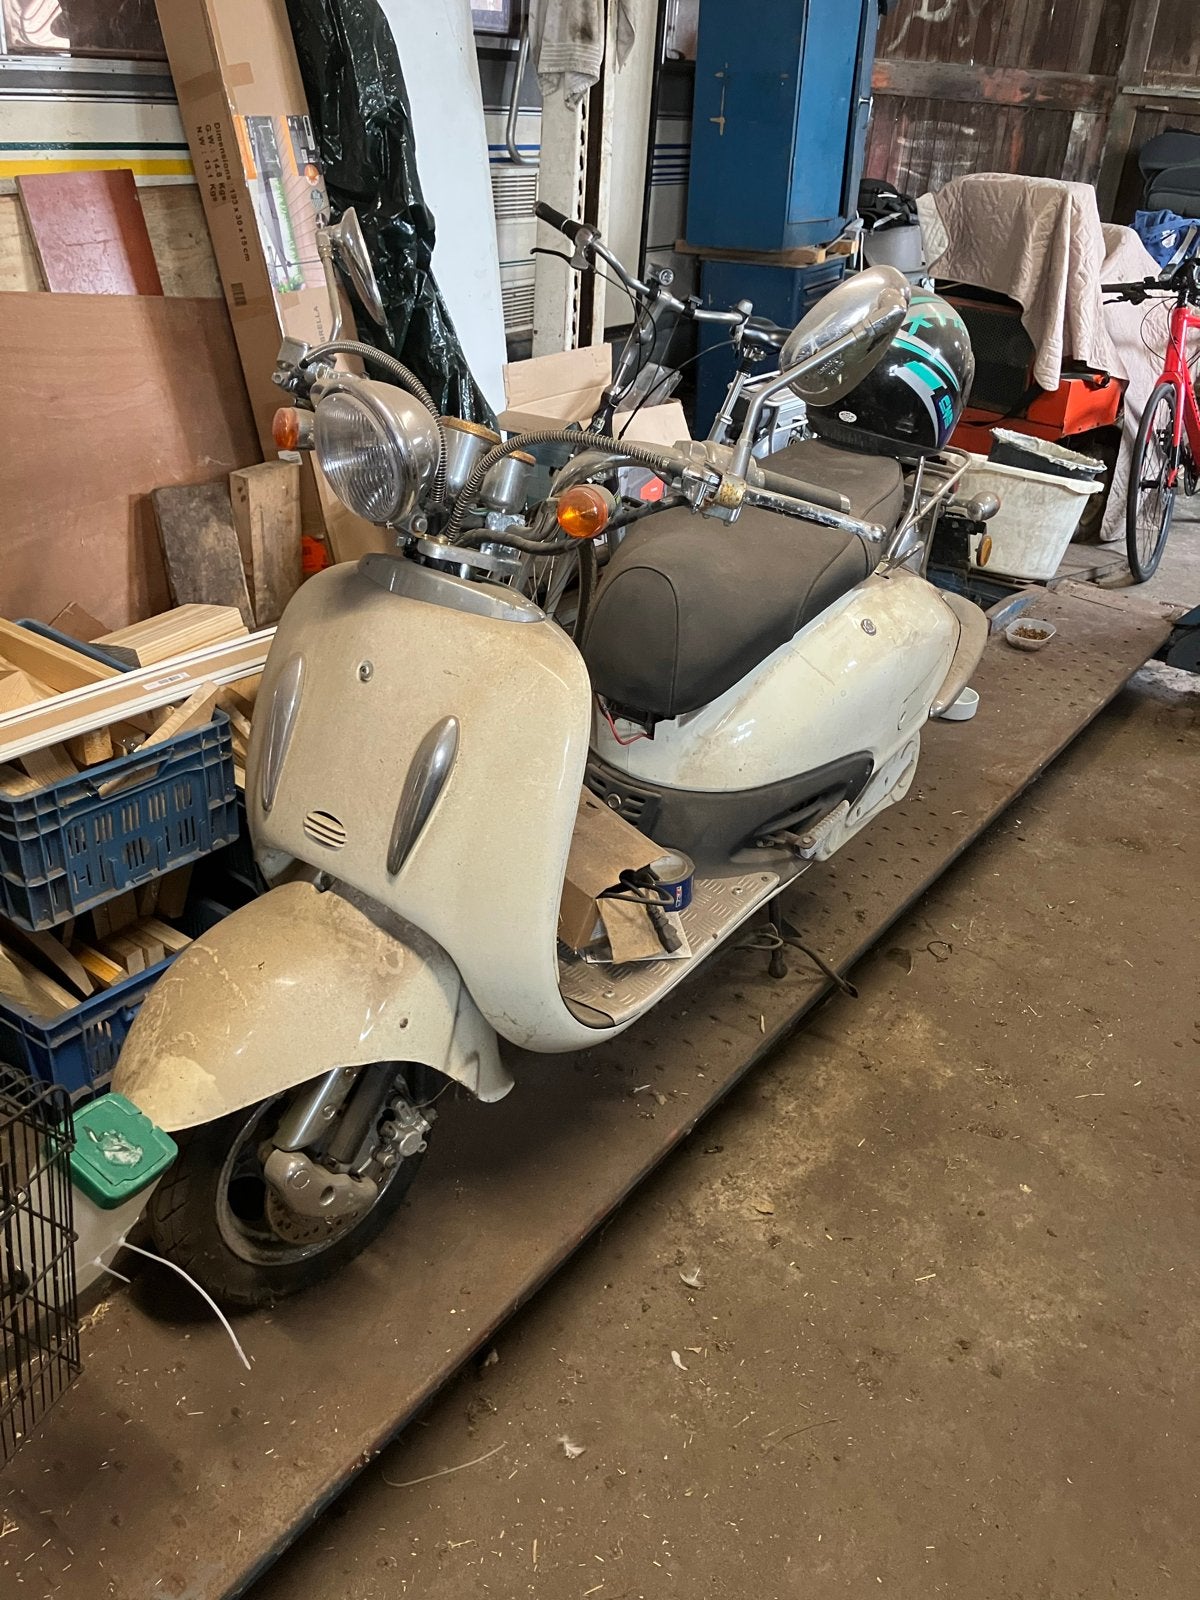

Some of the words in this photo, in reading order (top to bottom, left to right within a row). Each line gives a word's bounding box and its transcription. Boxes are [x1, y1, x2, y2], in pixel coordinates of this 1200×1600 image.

[214, 122, 231, 180] Dimensions
[235, 214, 243, 226] 30
[240, 235, 248, 246] 15
[243, 248, 250, 262] cm
[313, 305, 326, 343] BRELLA
